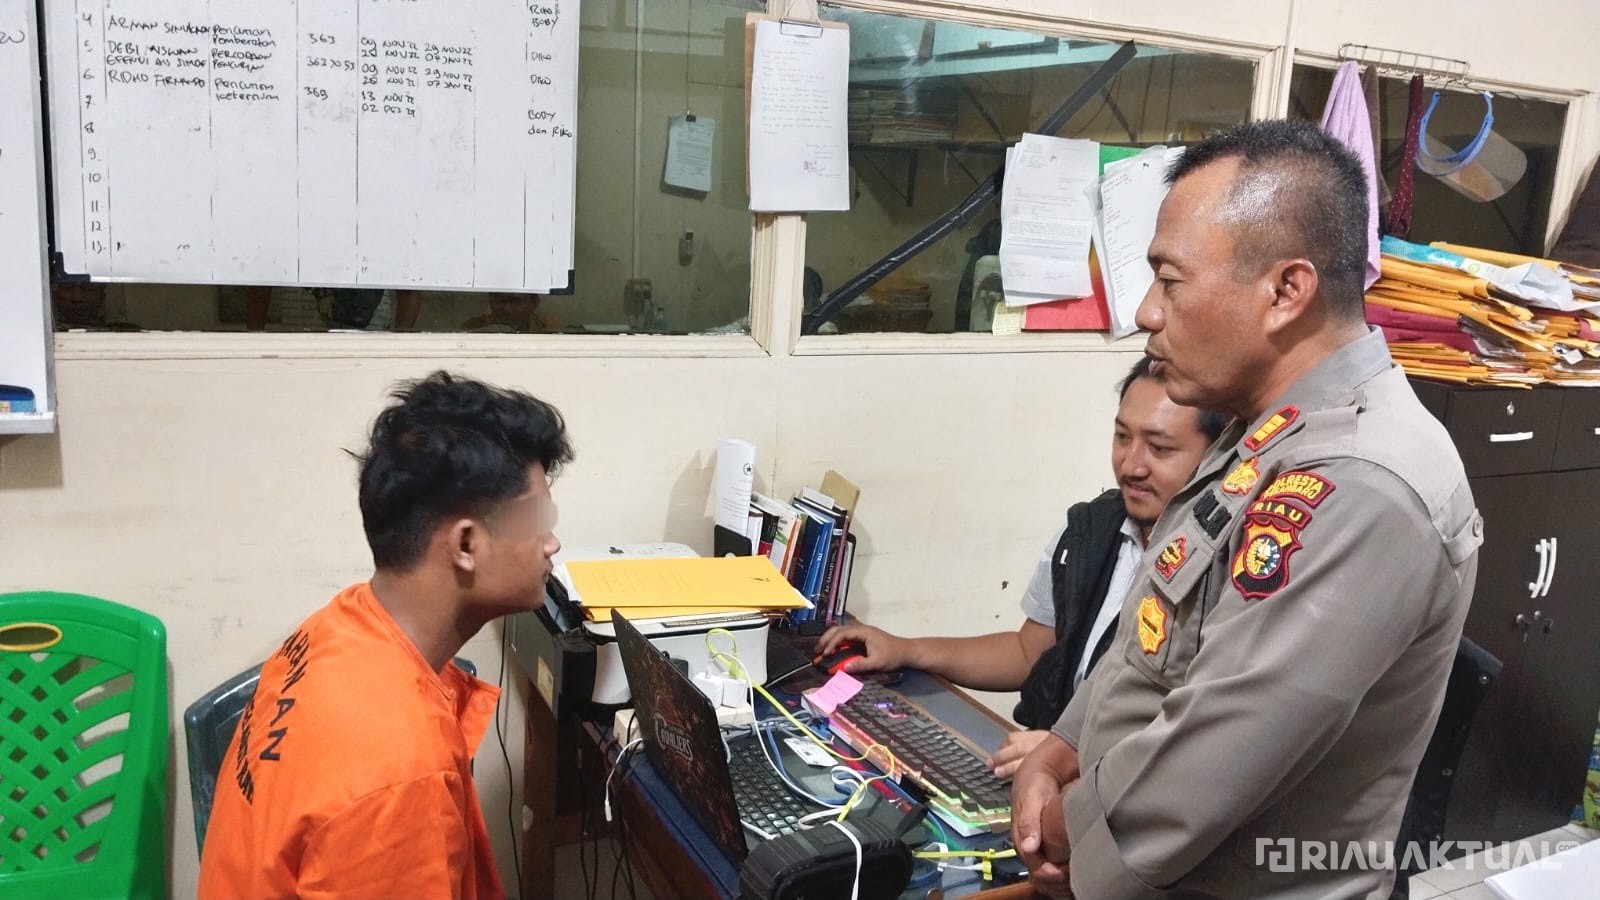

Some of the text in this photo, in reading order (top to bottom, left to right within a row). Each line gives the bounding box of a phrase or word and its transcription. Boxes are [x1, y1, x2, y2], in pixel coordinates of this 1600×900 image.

[108, 15, 158, 31] ARMAN
[107, 40, 140, 56] DEBI
[108, 69, 149, 84] RIDHO
[361, 90, 376, 101] 13
[361, 102, 379, 113] 02
[1254, 502, 1302, 522] RIAU
